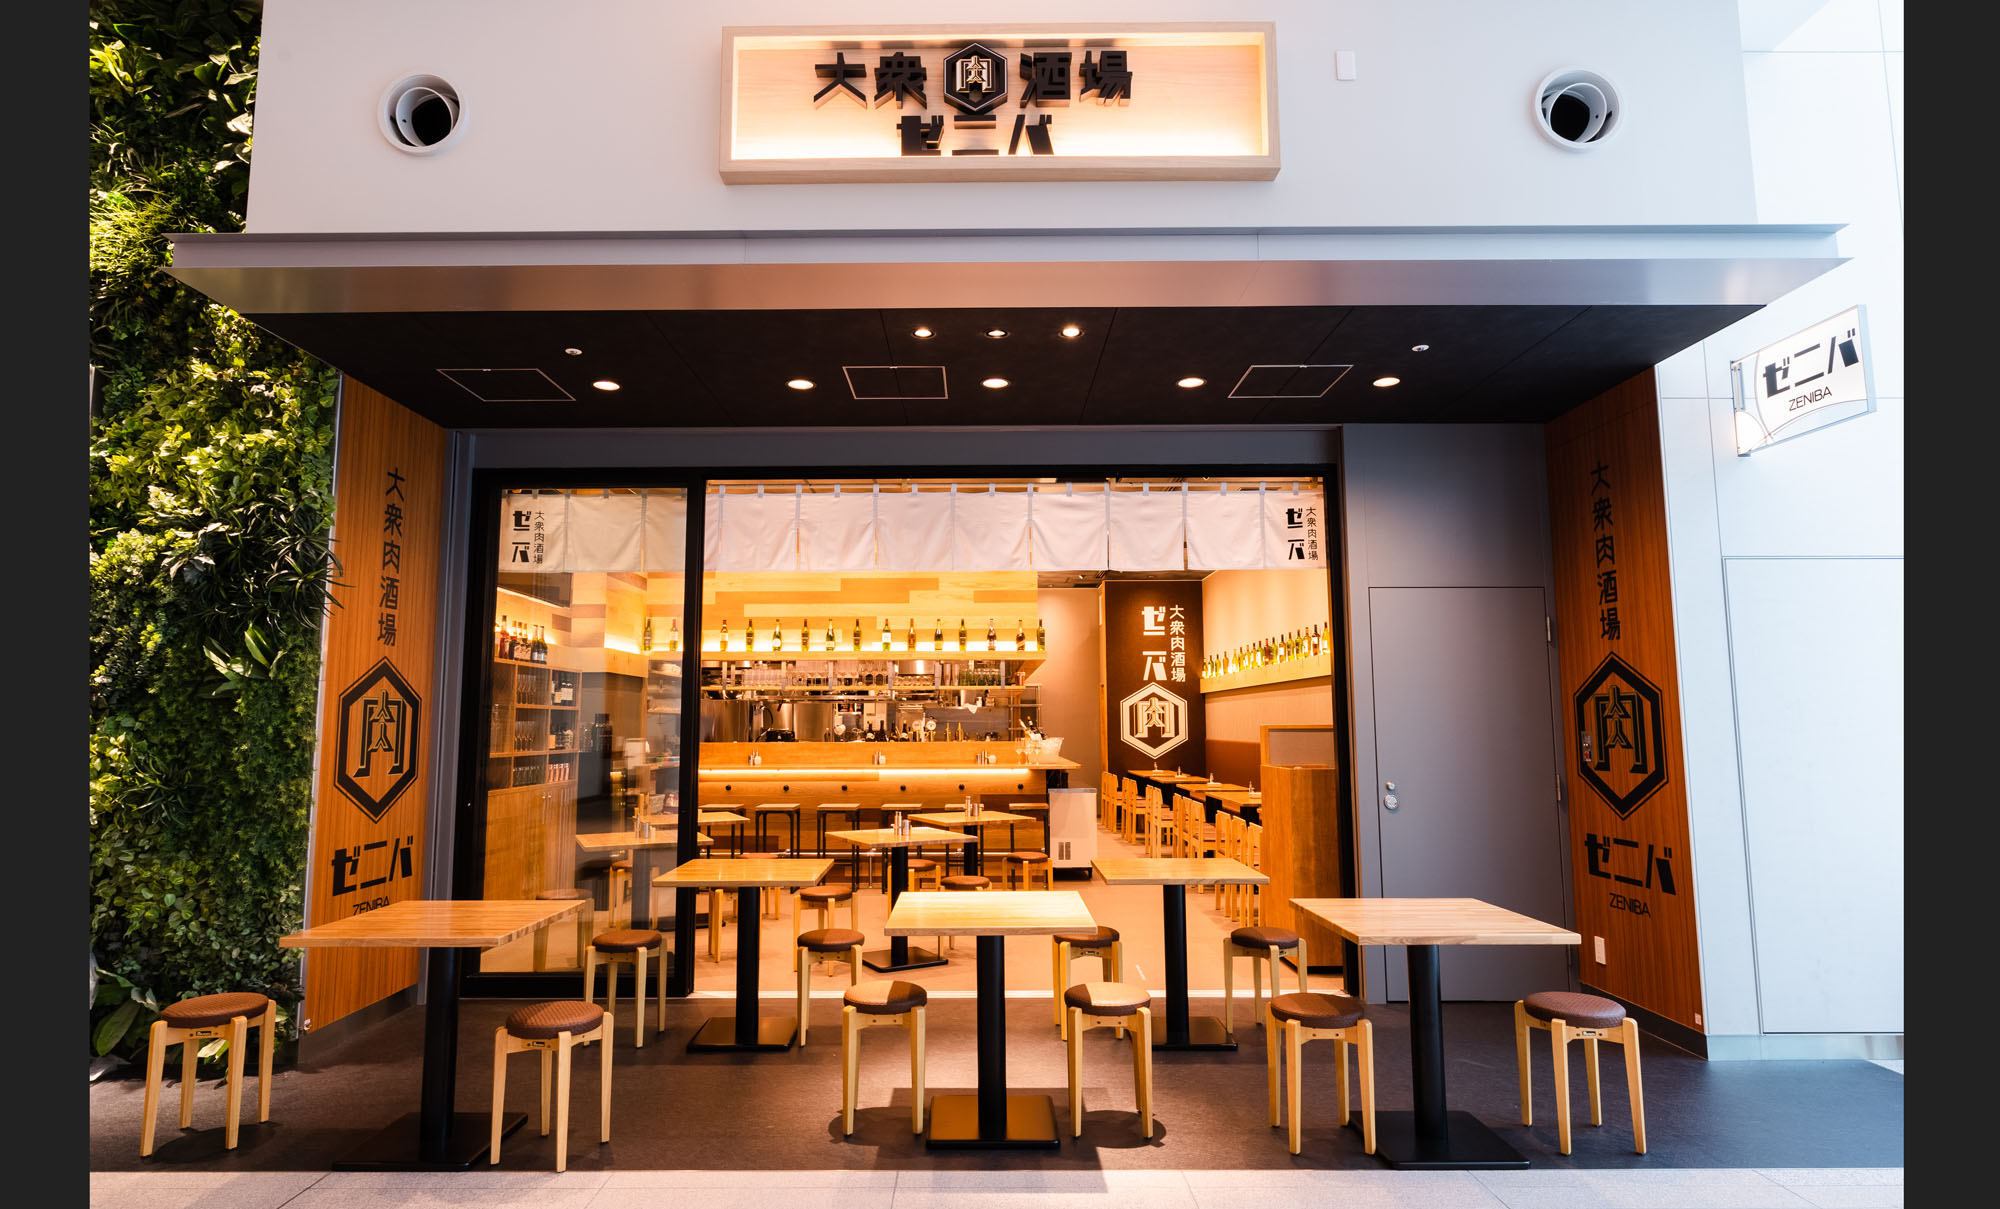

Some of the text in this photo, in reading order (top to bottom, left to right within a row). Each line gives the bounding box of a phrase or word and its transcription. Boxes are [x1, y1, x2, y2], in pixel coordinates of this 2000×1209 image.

[897, 114, 1054, 156] ゼニバ
[1762, 328, 1860, 398] ゼニバ
[1788, 386, 1833, 412] ZENIBA
[377, 466, 406, 647] 大衆肉酒場
[511, 510, 532, 563] ゼニバ
[533, 510, 545, 564] 大衆肉酒場
[1285, 507, 1305, 560] ゼニバ
[1306, 507, 1319, 561] 大衆肉酒場
[1589, 461, 1621, 641] 大衆肉酒場
[1141, 606, 1168, 681] ゼニバ
[1169, 604, 1186, 683] 大衆肉酒場
[331, 835, 414, 897] ゼニバ
[1584, 833, 1677, 895] ゼニバ
[1608, 893, 1651, 918] ZENIBA
